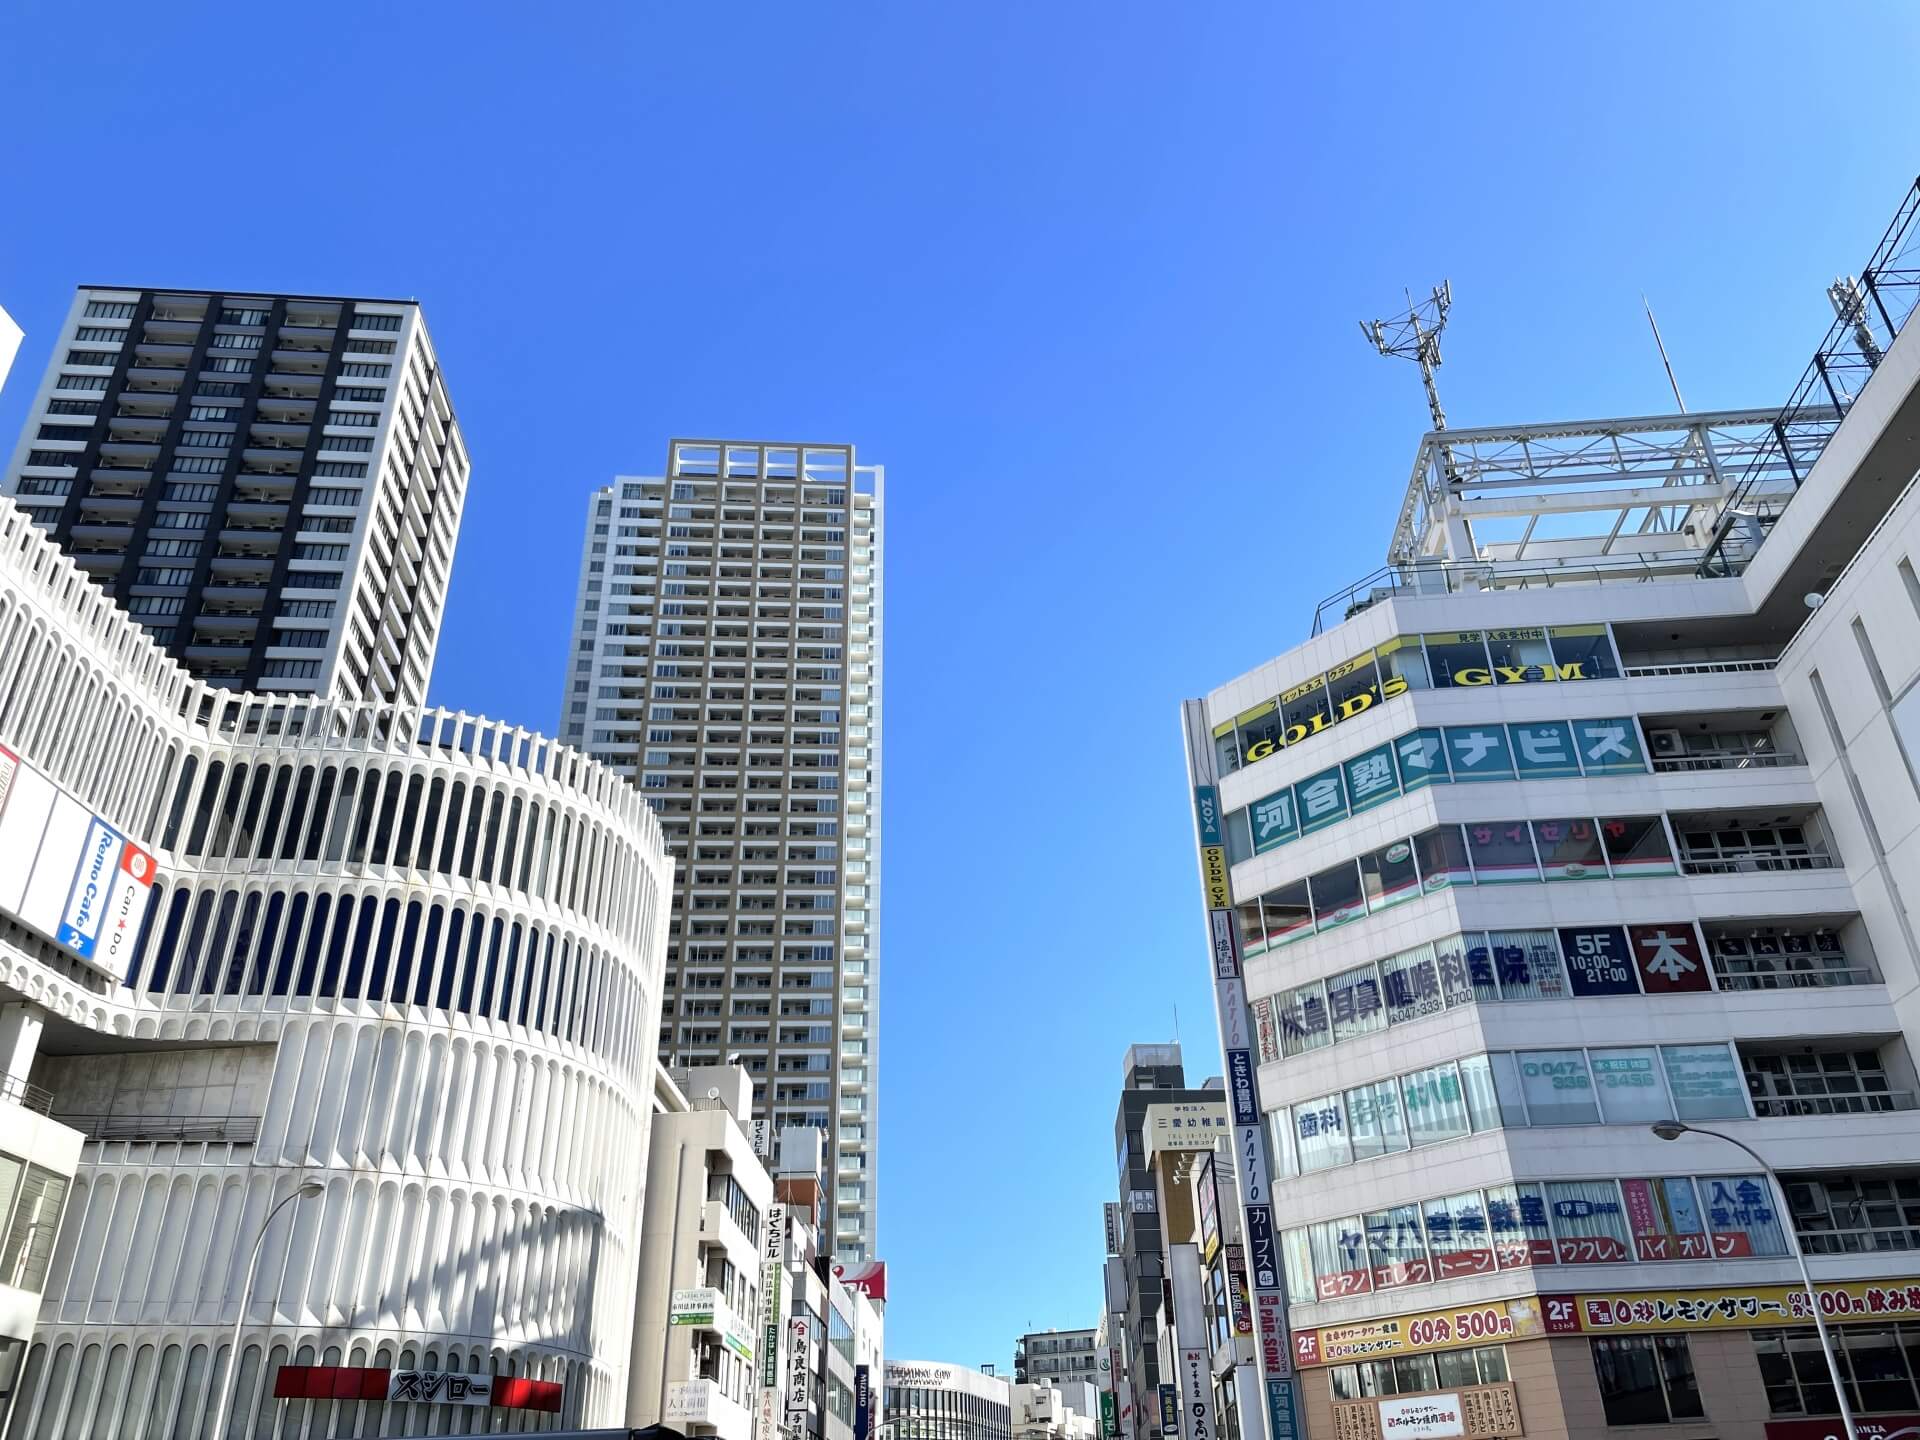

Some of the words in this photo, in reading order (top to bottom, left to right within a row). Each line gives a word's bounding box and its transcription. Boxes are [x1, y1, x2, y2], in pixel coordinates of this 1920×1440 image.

[1247, 674, 1409, 762] GOLD'S
[1454, 662, 1587, 686] GYM
[1201, 798, 1214, 834] NOVA
[1472, 819, 1627, 845] サイゼリヤ
[1211, 886, 1226, 907] GYM
[67, 931, 84, 950] 2F
[1576, 934, 1610, 955] 5F
[1641, 930, 1697, 981] 本
[1586, 967, 1627, 983] 21:00
[1227, 982, 1239, 1046] PATIO
[1233, 1053, 1252, 1114] ときわ書房
[1298, 1105, 1342, 1139] 歯科
[1245, 1128, 1259, 1201] PATIO
[1712, 1180, 1761, 1206] 入会
[1711, 1208, 1772, 1227] 受付中
[767, 1207, 782, 1259] はぐちビル
[1252, 1208, 1272, 1269] カーブス
[1259, 1273, 1272, 1284] 4F
[1319, 1274, 1366, 1297] ピアノ
[1547, 1300, 1574, 1320] 2F
[1239, 1320, 1251, 1331] 3F
[1409, 1317, 1451, 1346] 60分
[1455, 1309, 1513, 1339] 500円
[1298, 1336, 1316, 1354] 2F
[860, 1373, 868, 1407] MIZUHO
[1855, 1425, 1886, 1433] INZA
